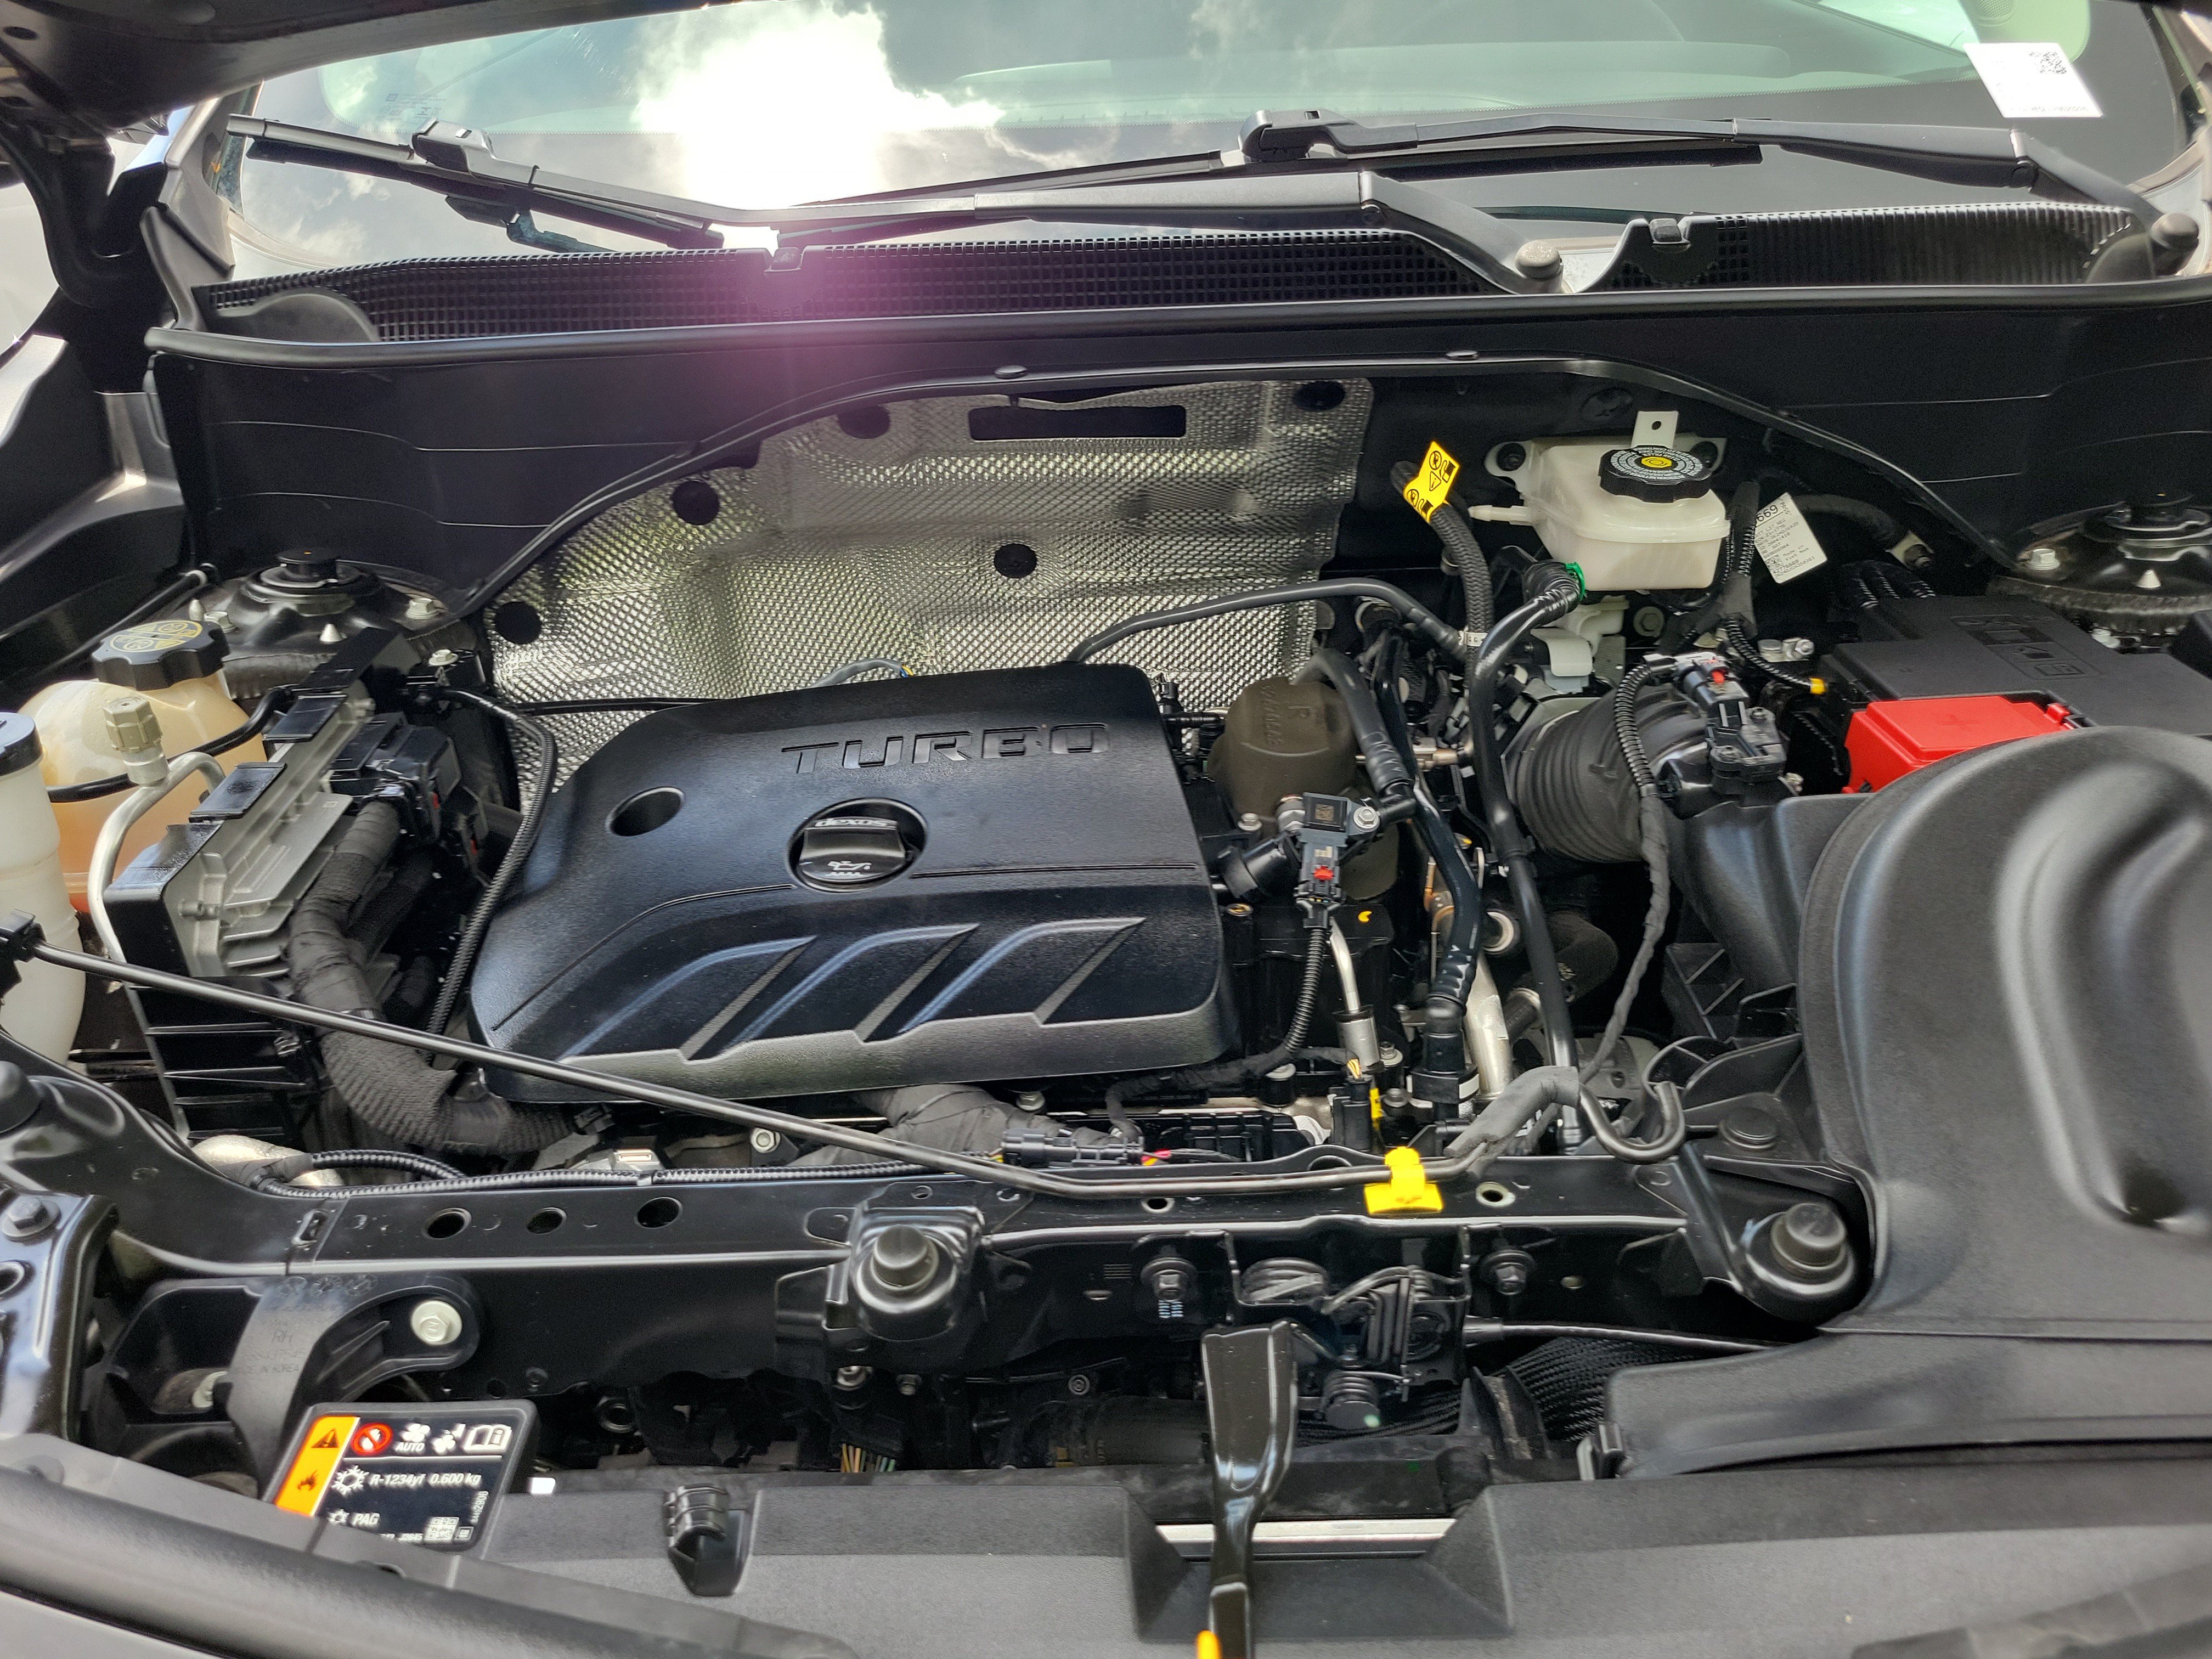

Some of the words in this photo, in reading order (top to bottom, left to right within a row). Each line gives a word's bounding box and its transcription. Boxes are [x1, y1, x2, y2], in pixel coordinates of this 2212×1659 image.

[781, 723, 1108, 774] TURBO
[815, 818, 888, 827] dexos
[396, 1442, 425, 1452] AUTO
[370, 1473, 425, 1486] R-1234yf
[430, 1474, 464, 1486] 0.600
[465, 1473, 481, 1487] kg
[352, 1513, 380, 1526] PAG
